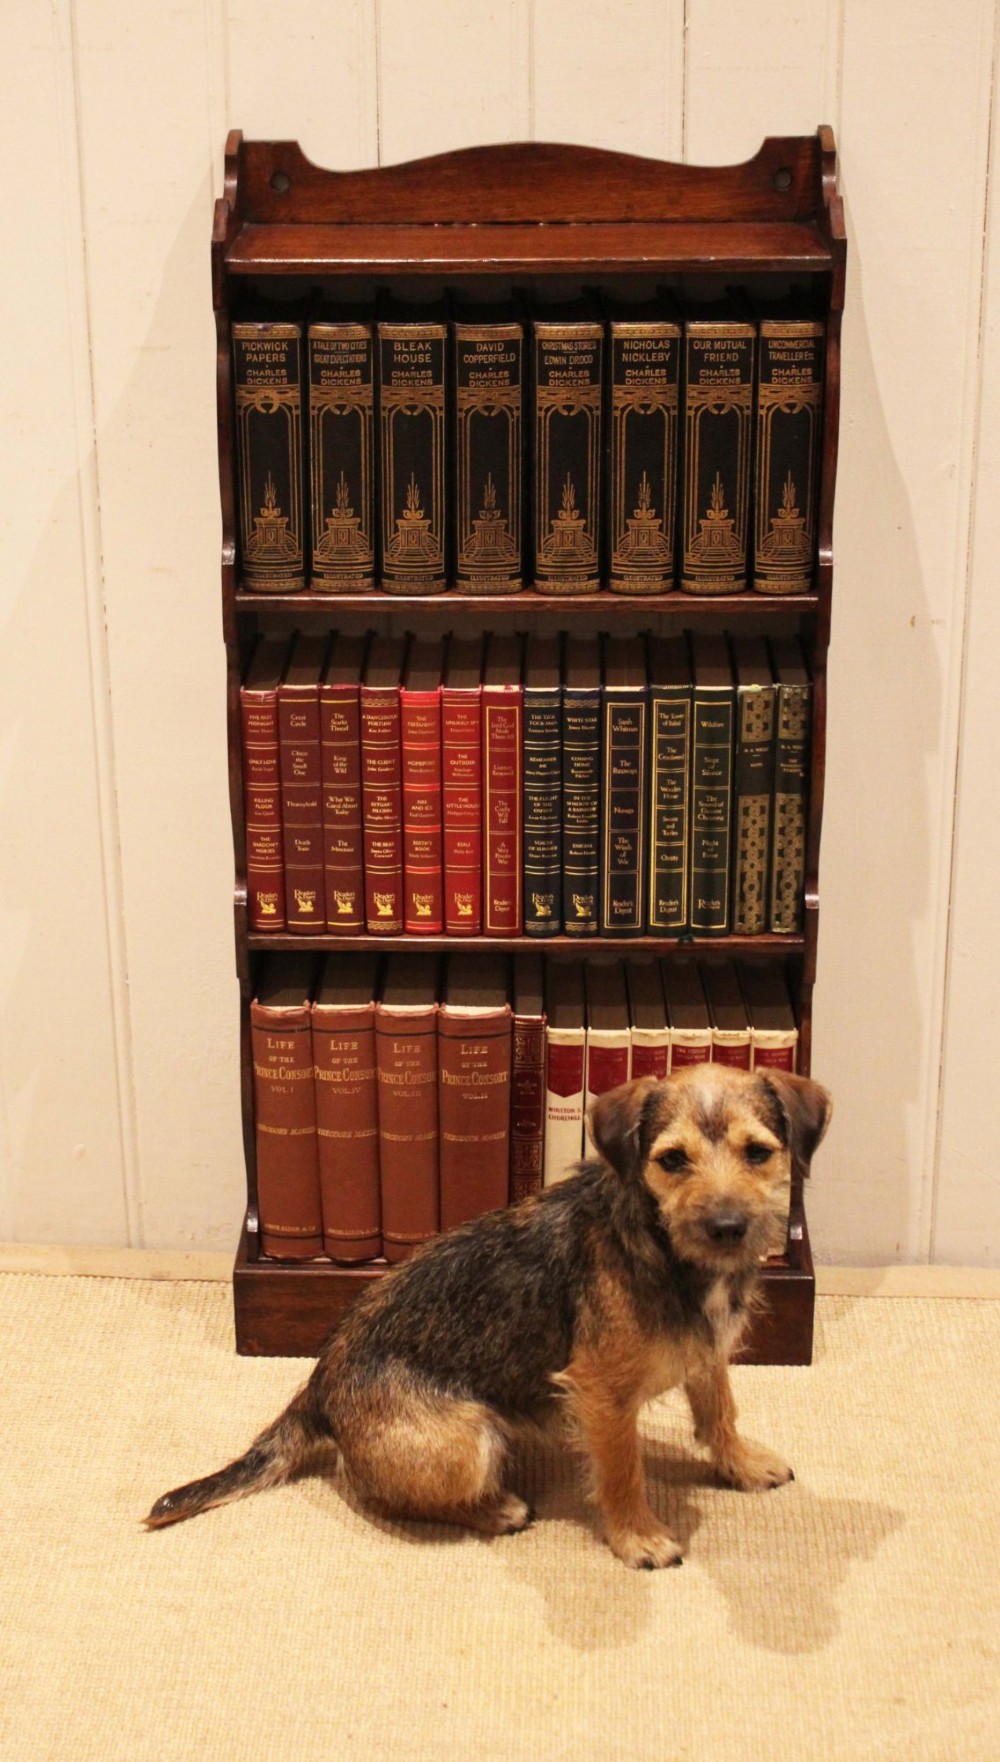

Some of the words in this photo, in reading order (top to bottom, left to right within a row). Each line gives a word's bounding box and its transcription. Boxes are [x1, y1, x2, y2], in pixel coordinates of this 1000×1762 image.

[242, 341, 289, 351] PICKWICK
[337, 341, 350, 350] TWO
[350, 341, 367, 350] CITIES
[394, 341, 432, 351] BLEAK
[476, 342, 504, 352] DAVID
[541, 341, 574, 351] CHRISTMAS
[573, 341, 596, 351] STORIES
[623, 340, 671, 350] NICHOLAS
[692, 340, 712, 350] OUR
[714, 340, 747, 350] MUTUAL
[768, 340, 816, 349] UNCOMMERCIAL
[245, 353, 286, 363] PAPERS
[314, 354, 330, 363] GREAT
[330, 354, 367, 364] EXPECTATIONS
[393, 353, 432, 363] HOUSE
[463, 352, 516, 364] COPPERFIELD
[544, 355, 567, 365] EDWIN
[569, 354, 593, 365] DROOD
[622, 352, 671, 362] NICKLEBY
[703, 352, 739, 362] FRIEND
[768, 351, 803, 361] TRAVELLER
[246, 369, 287, 377] CHARLES
[391, 370, 433, 378] CHARLES
[469, 371, 510, 379] CHARLES
[548, 370, 590, 378] CHARLES
[625, 369, 666, 377] CHARLES
[771, 368, 813, 376] CHARLES
[246, 377, 288, 385] DICKENS
[320, 378, 361, 386] DICKENS
[391, 379, 433, 387] DICKENS
[469, 379, 510, 387] DICKENS
[548, 378, 590, 386] DICKENS
[625, 377, 667, 385] DICKENS
[699, 377, 741, 385] DICKENS
[771, 376, 813, 384] DICKENS
[323, 572, 364, 580] ILLUSTRATED
[622, 574, 663, 582] ILLUSTRATED
[666, 746, 677, 754] The
[619, 759, 631, 767] The
[337, 839, 349, 847] The
[313, 1065, 342, 1082] PRINCE
[442, 1069, 471, 1086] PRINCE
[471, 1071, 508, 1086] CONSORT
